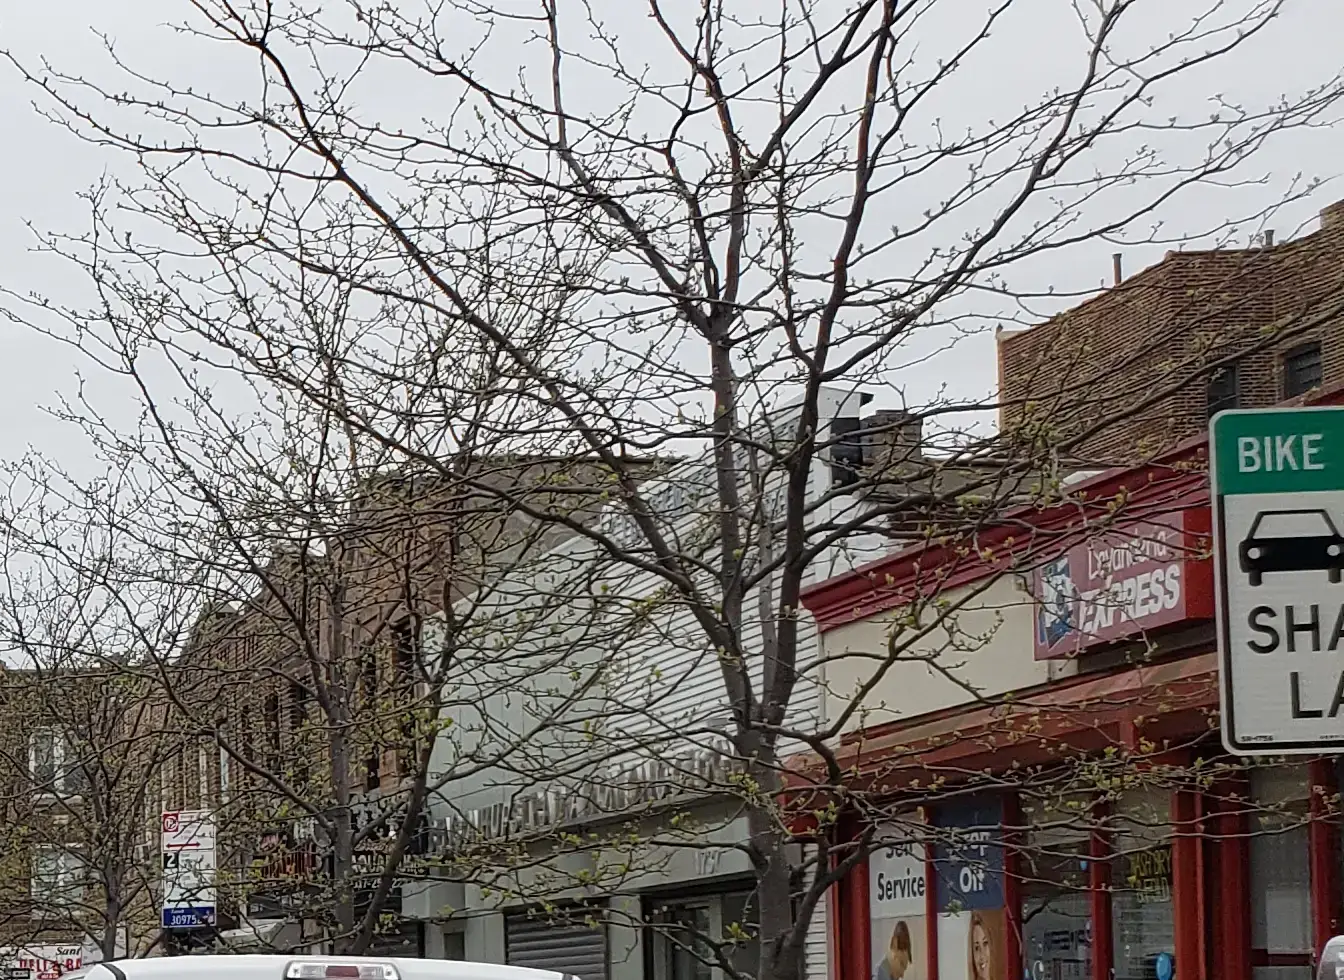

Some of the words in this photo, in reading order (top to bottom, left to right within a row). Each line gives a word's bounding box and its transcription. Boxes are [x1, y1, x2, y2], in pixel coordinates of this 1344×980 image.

[1238, 434, 1326, 473] BIKE
[1079, 563, 1180, 641] EXPRESS
[877, 868, 925, 901] Service
